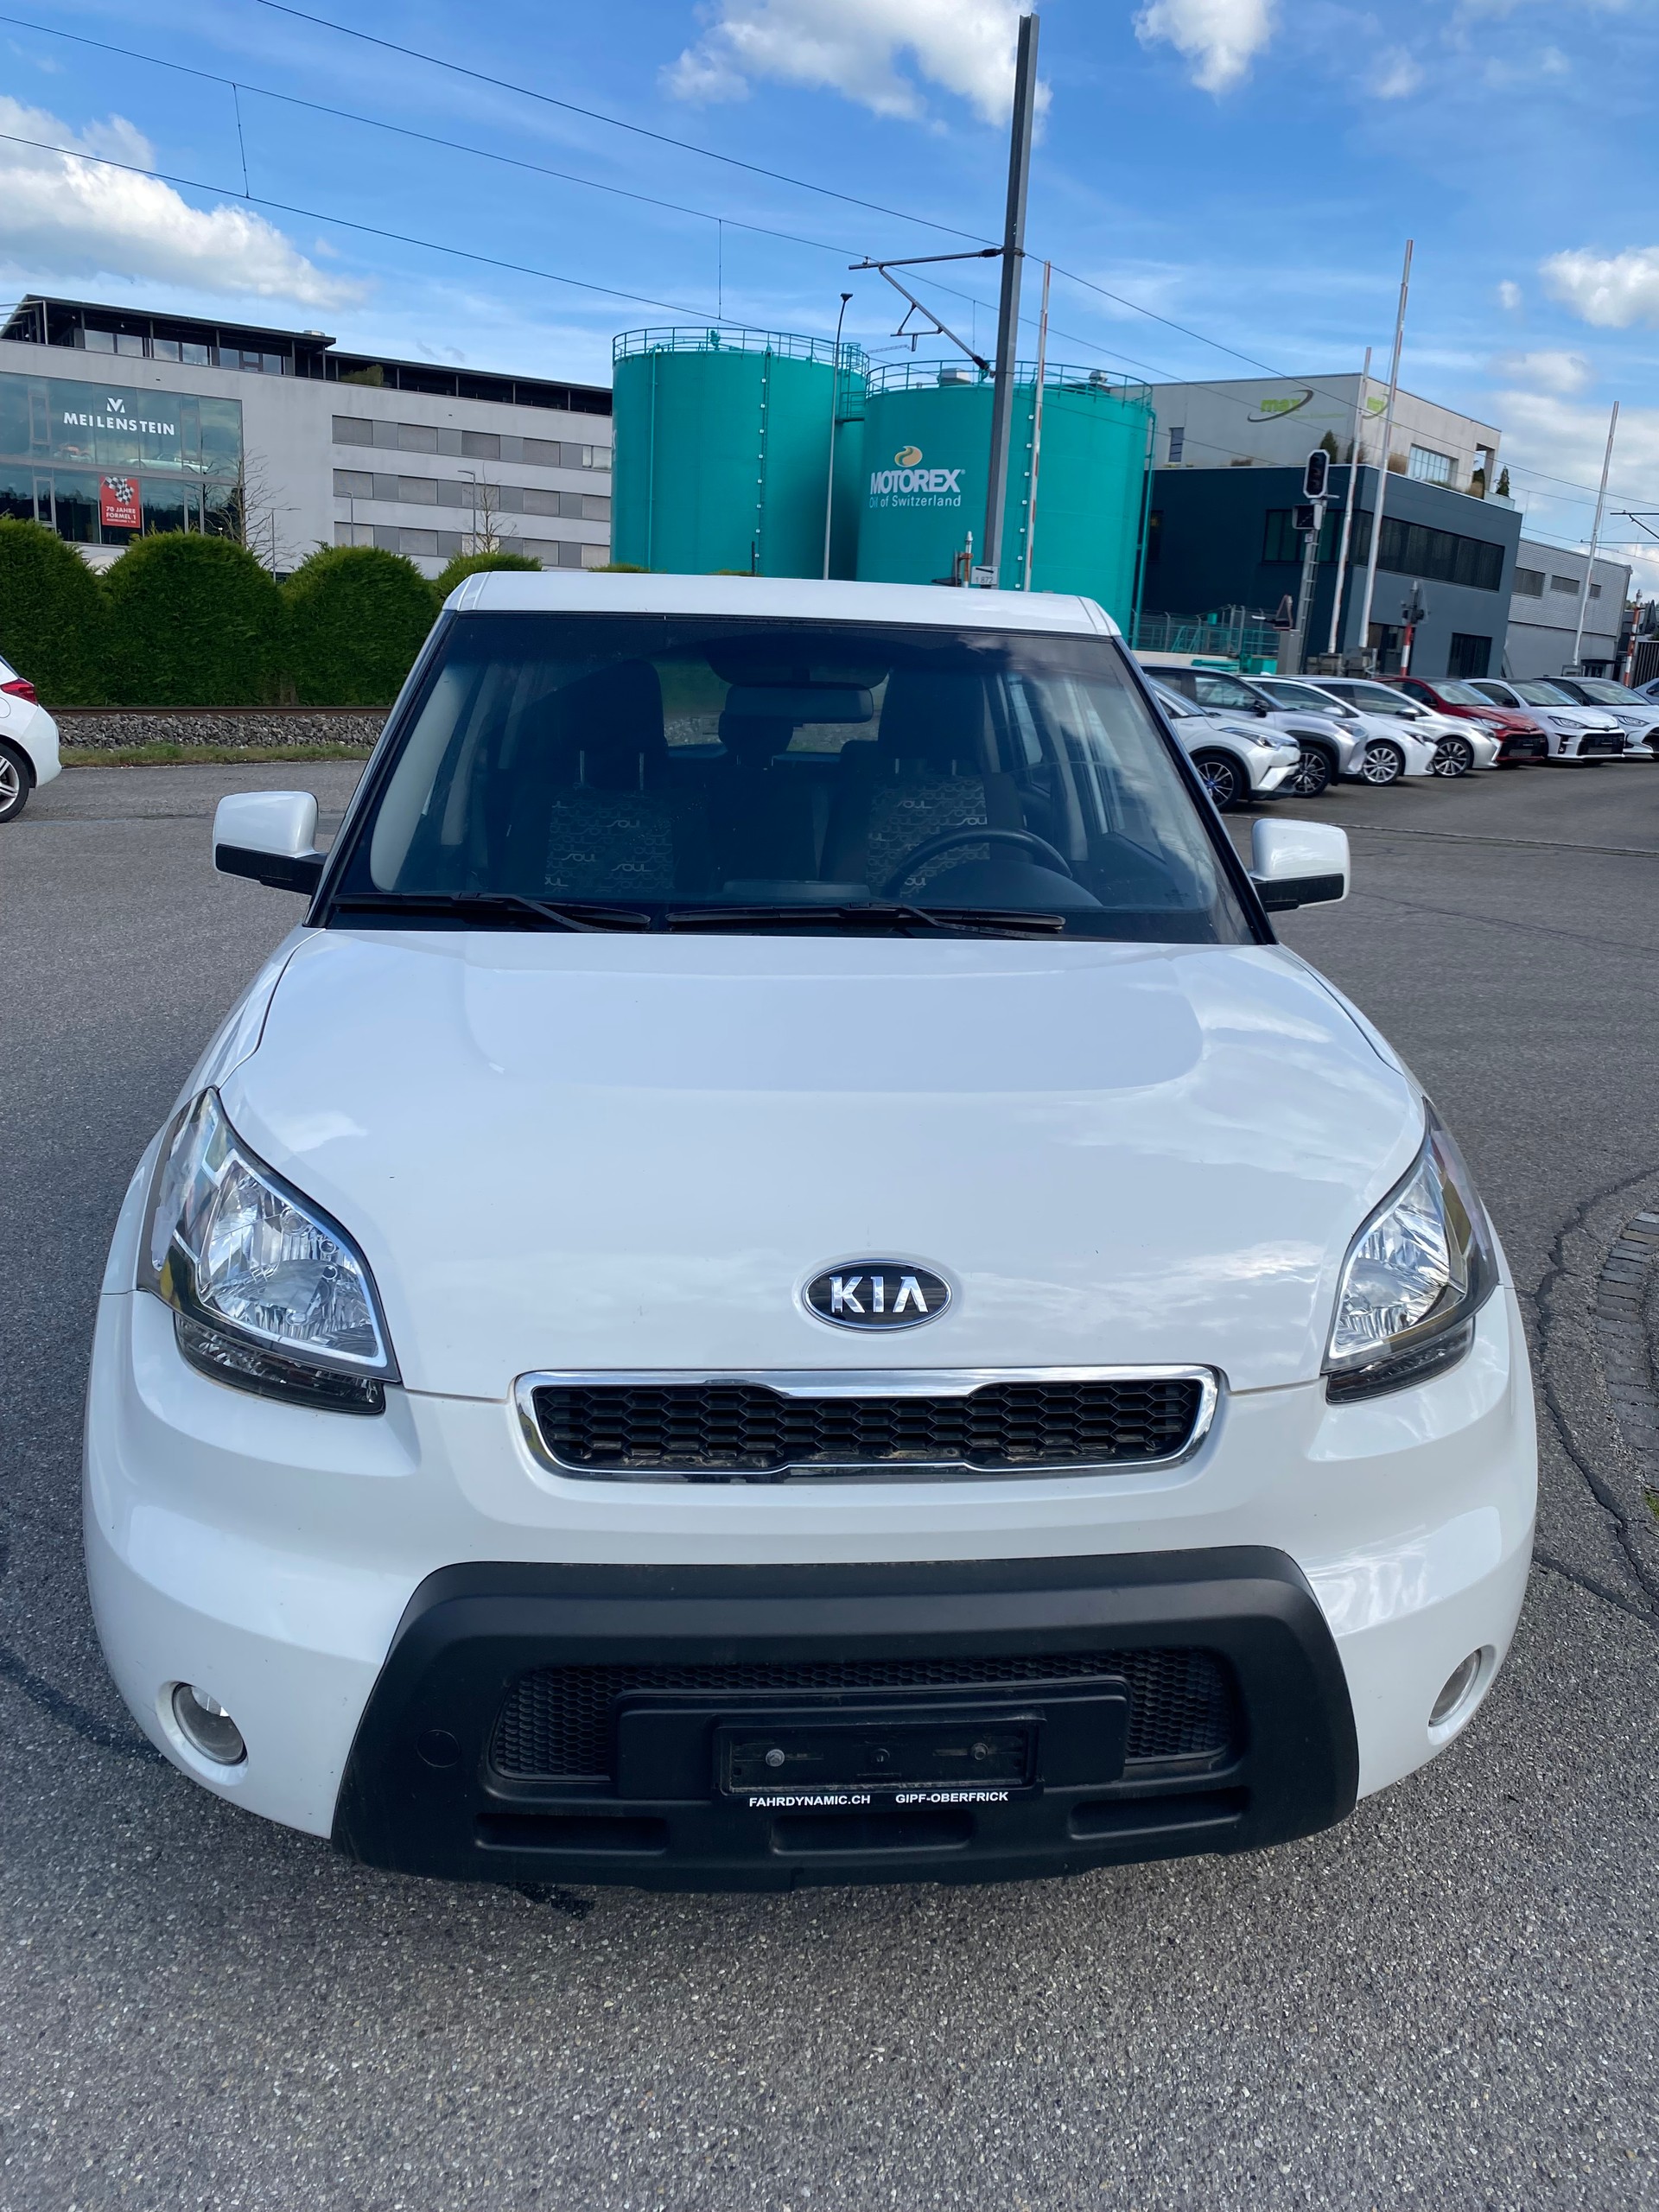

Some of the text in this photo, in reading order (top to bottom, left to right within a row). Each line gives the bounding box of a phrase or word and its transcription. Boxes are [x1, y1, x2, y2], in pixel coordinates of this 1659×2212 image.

[63, 411, 175, 435] MEILENSTEIN
[869, 494, 962, 508] Oil of Switzerland
[829, 1275, 929, 1313] KIA
[749, 1791, 1009, 1808] FAHRDYNAMIC.CH GIPF-OBERFRICK
